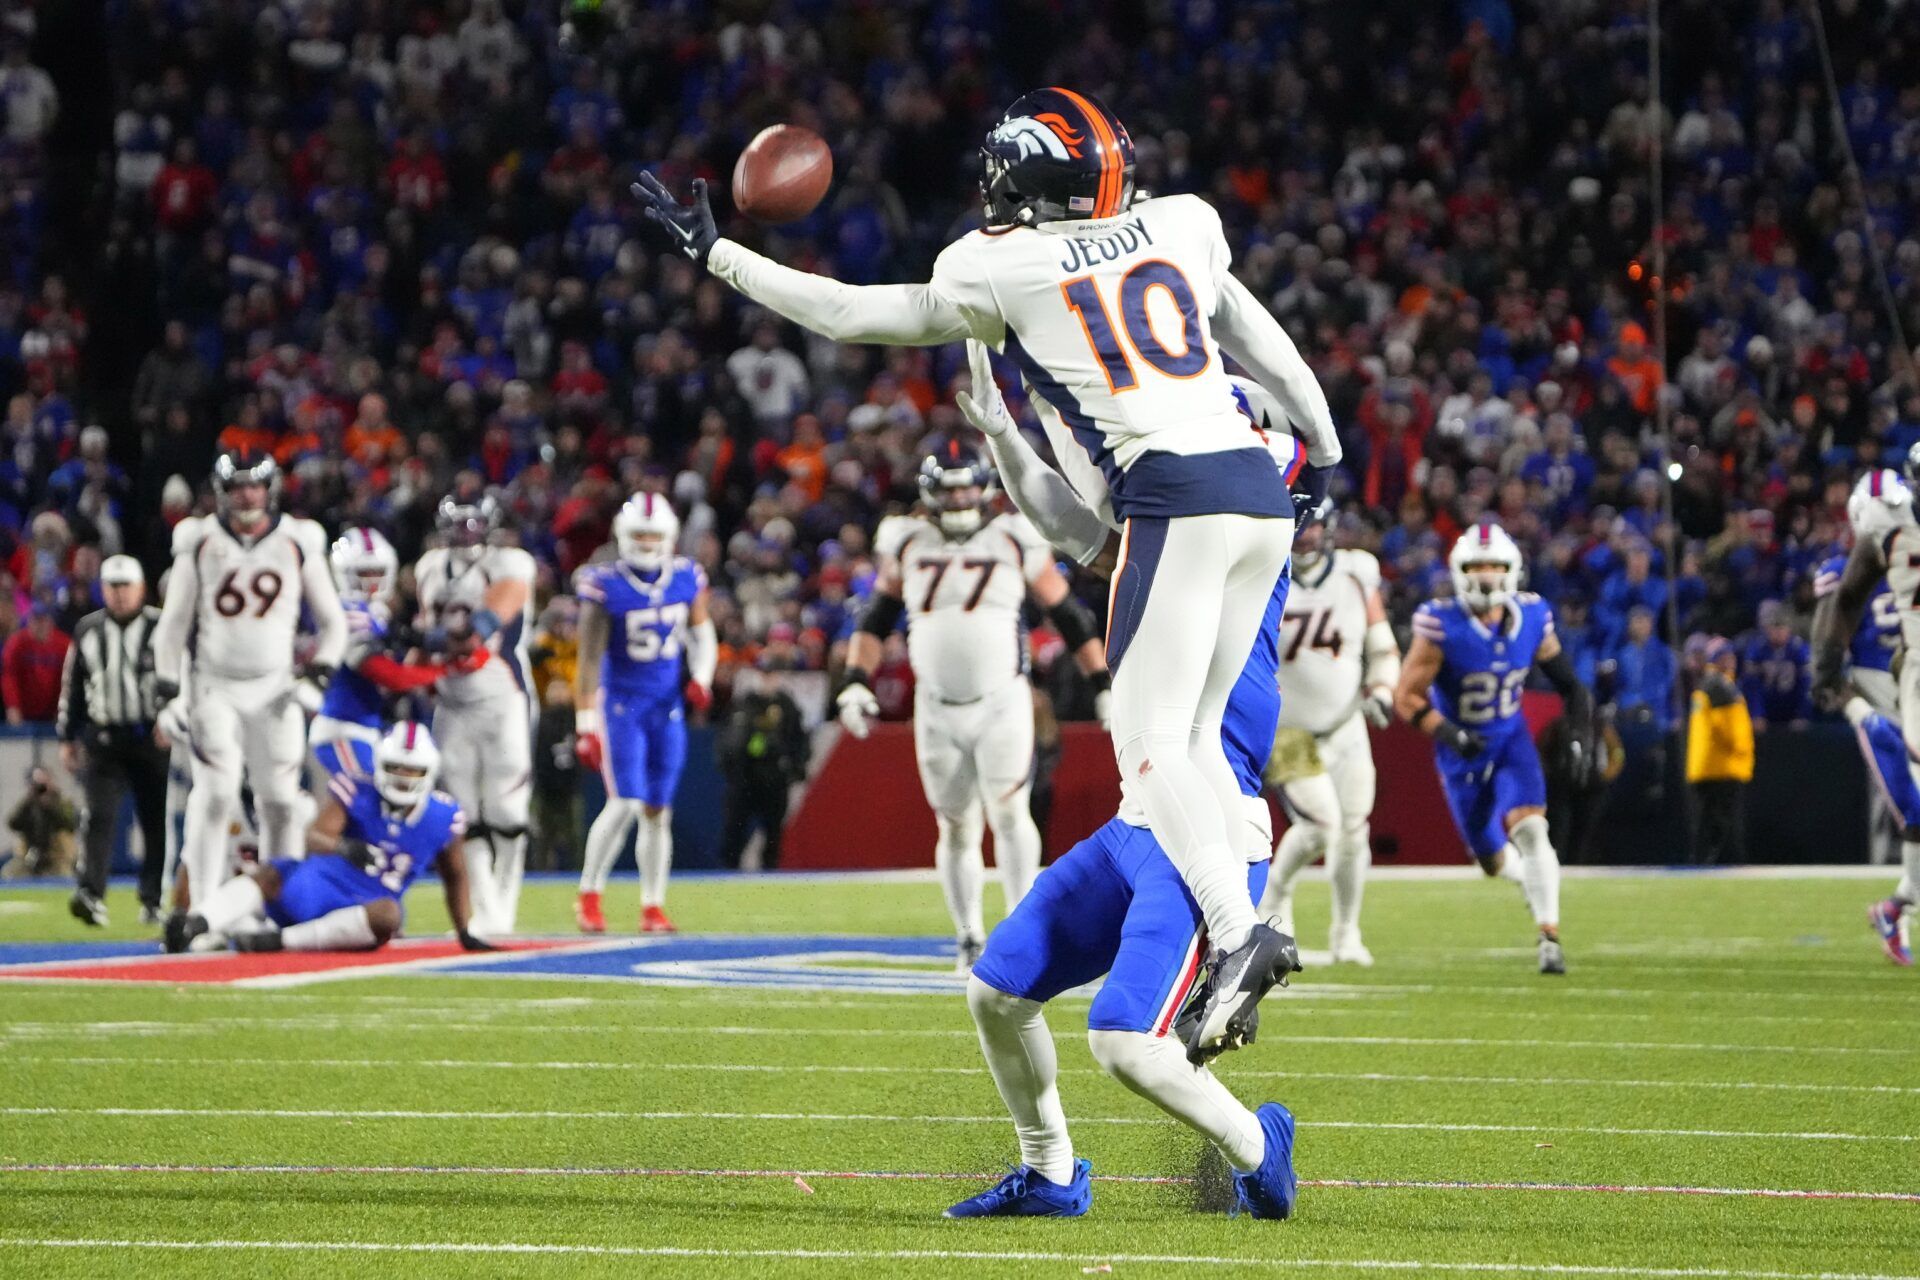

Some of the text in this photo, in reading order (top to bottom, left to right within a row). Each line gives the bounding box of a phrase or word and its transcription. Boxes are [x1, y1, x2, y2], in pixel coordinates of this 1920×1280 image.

[1061, 216, 1154, 273] JEUDY
[1060, 257, 1211, 395] 10
[214, 567, 283, 618] 69
[917, 557, 999, 613] 77
[625, 601, 689, 662] 57
[1282, 607, 1344, 663] 74
